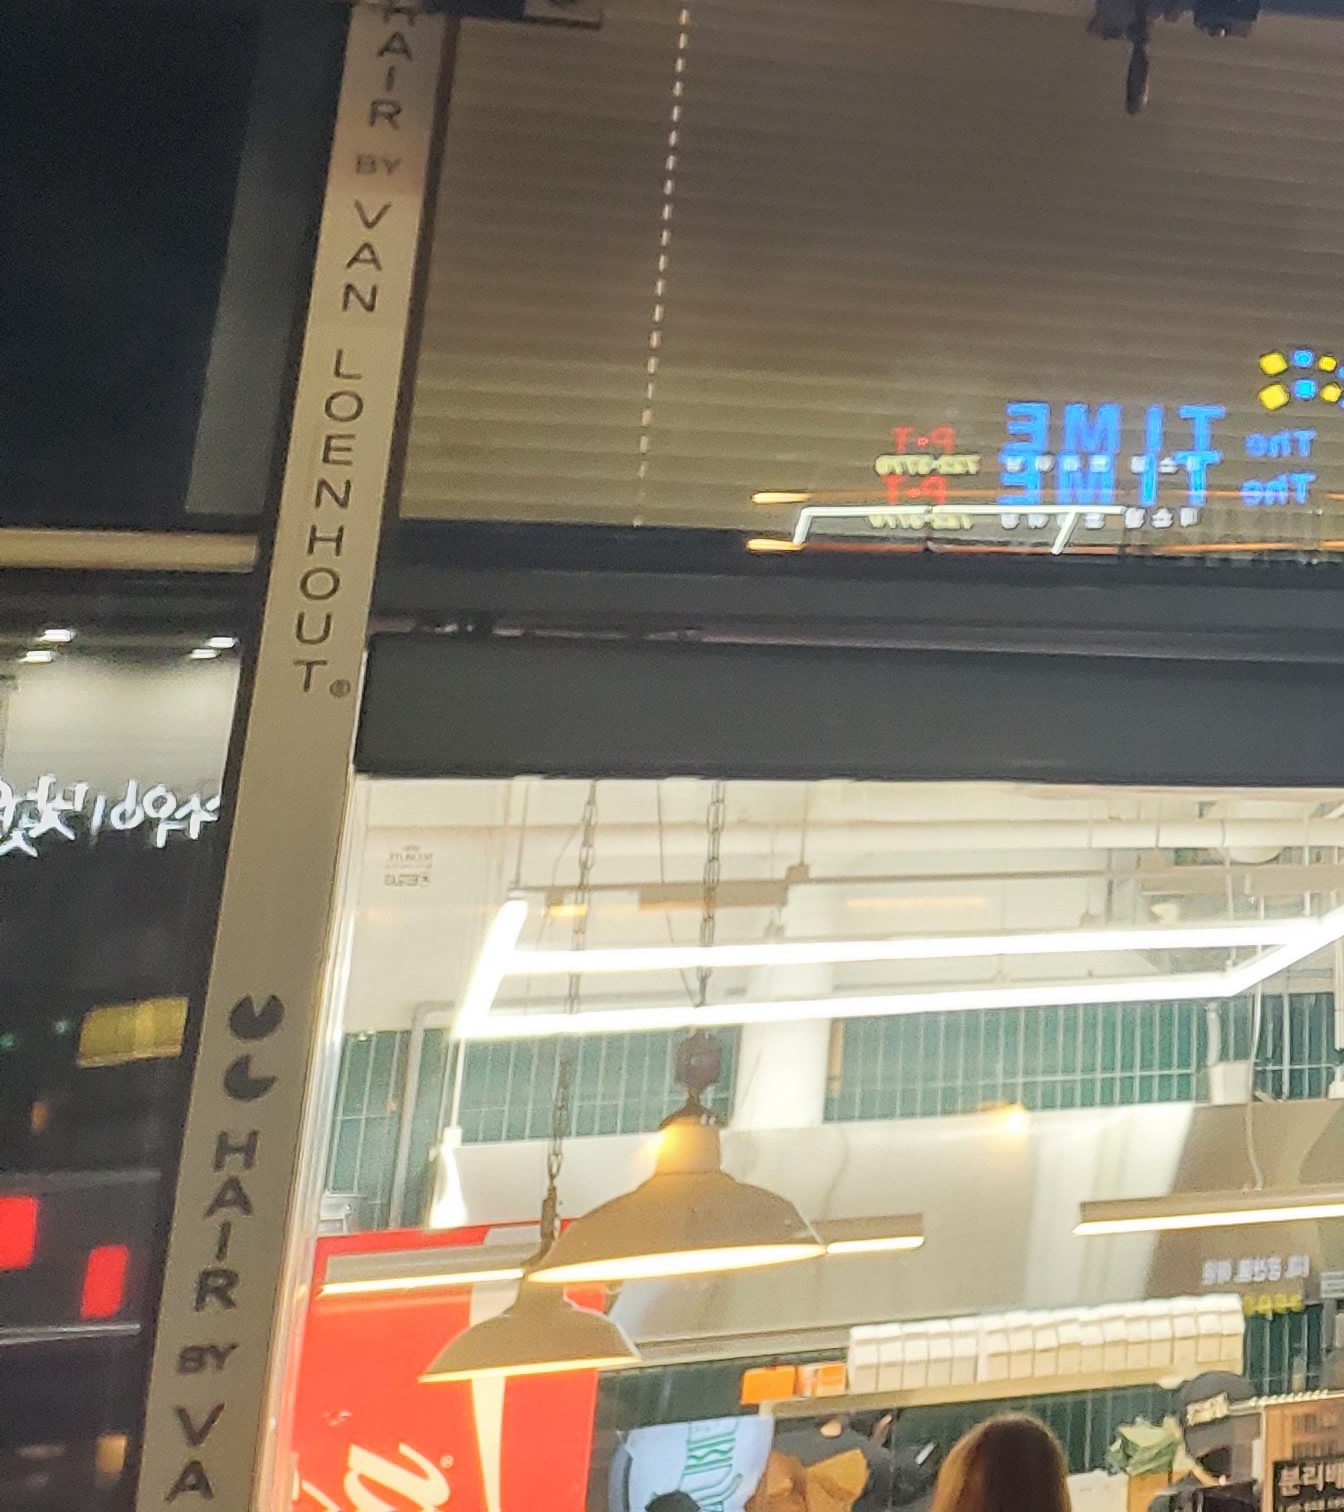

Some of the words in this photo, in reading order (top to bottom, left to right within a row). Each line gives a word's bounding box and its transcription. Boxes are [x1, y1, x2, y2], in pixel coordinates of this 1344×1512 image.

[355, 153, 403, 177] BY
[341, 199, 393, 314] VAN
[193, 1129, 260, 1312] HAIR
[175, 1342, 239, 1376] BY
